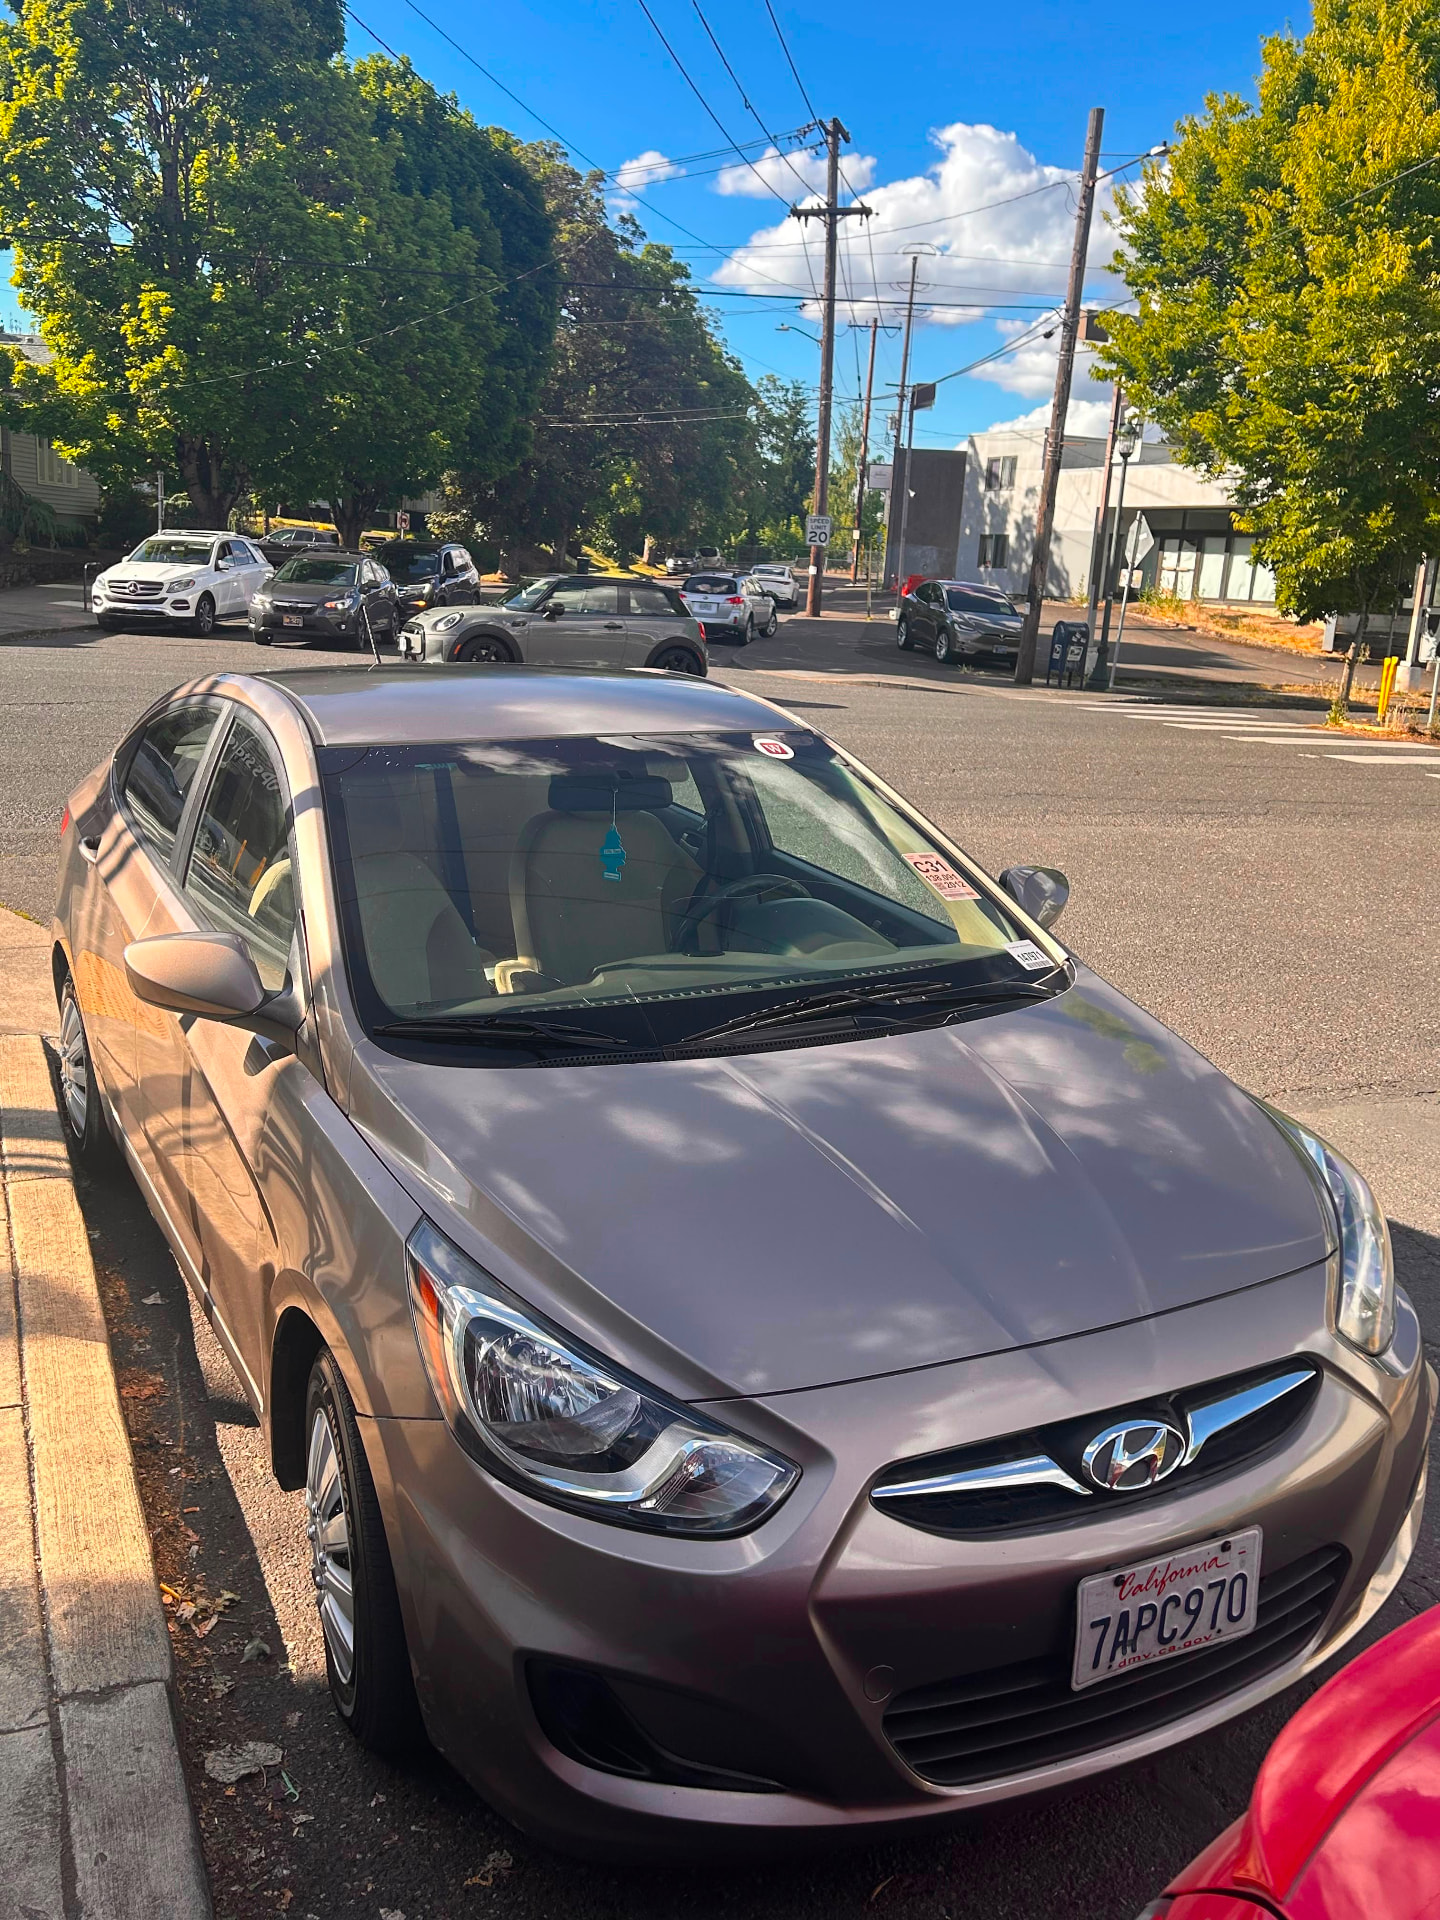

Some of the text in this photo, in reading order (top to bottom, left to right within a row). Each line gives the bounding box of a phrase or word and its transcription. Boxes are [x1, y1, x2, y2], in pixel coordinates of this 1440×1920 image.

[808, 531, 828, 543] 20
[913, 860, 948, 873] C31
[944, 880, 967, 889] 2012
[1118, 1552, 1230, 1601] California
[1089, 1572, 1249, 1670] 7APC970
[1118, 1633, 1213, 1669] dmv.ca.gov
